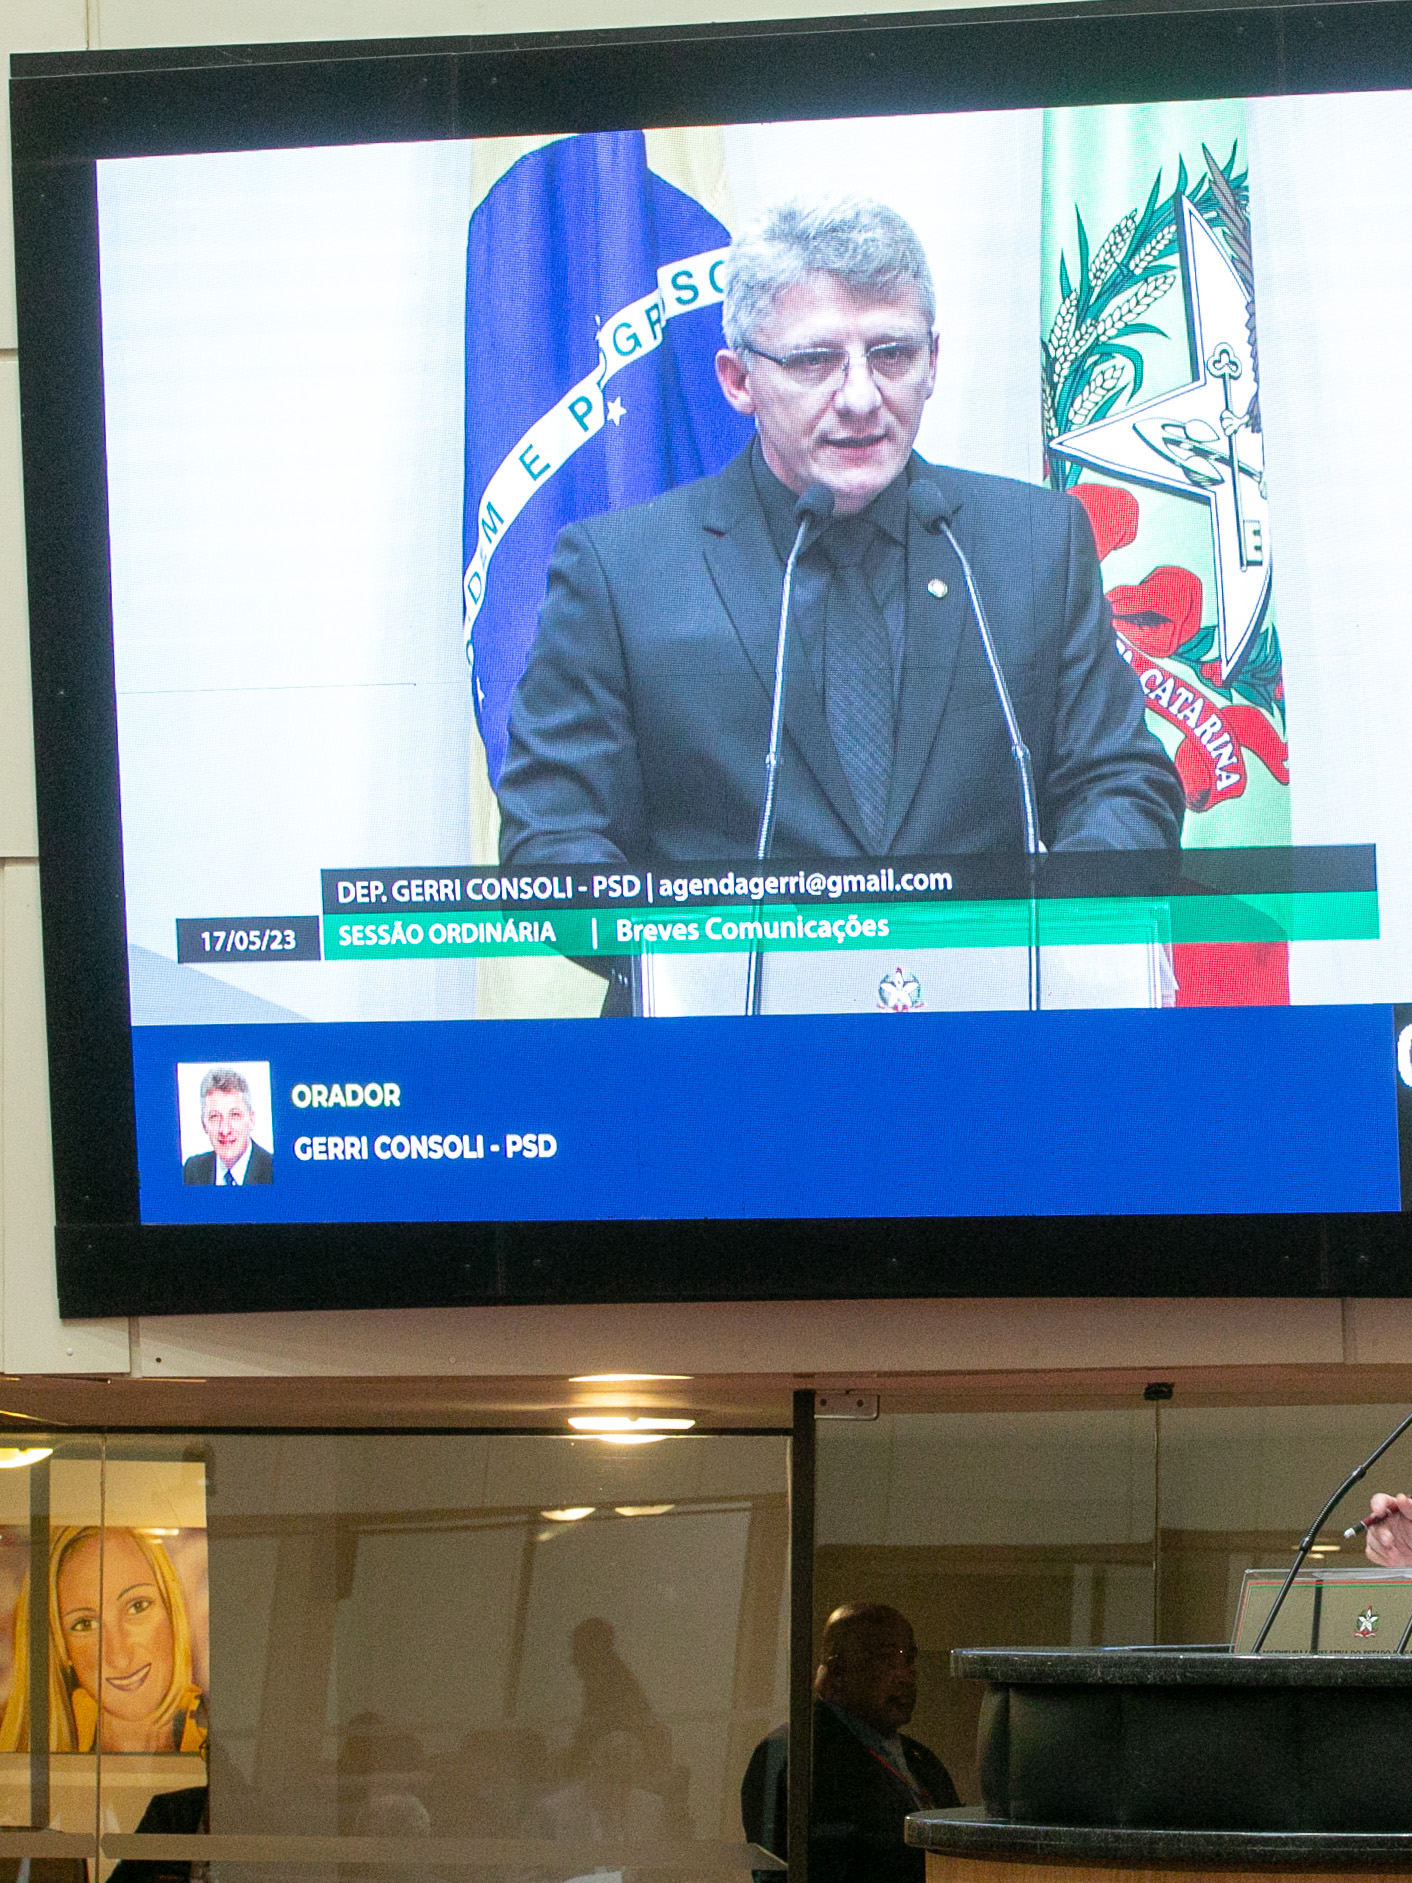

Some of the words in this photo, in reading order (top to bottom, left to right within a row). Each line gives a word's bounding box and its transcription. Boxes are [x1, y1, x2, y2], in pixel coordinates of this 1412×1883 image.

[1138, 668, 1242, 791] CATARINA
[336, 880, 388, 904] DEP.
[391, 878, 462, 902] GERRI
[466, 876, 573, 900] CONSOLI
[592, 874, 641, 898] PSD
[657, 868, 953, 902] agendagerri@gmail.com
[200, 928, 297, 952] 17/05/23
[338, 920, 424, 946] SESSÃO
[428, 918, 557, 944] ORDINÁRIA
[616, 918, 700, 942] Breves
[704, 914, 890, 944] Comunicações
[291, 1082, 402, 1109] ORADOR
[293, 1135, 369, 1161] GERRI
[373, 1134, 485, 1160] CONSOLI
[505, 1133, 558, 1159] PSD
